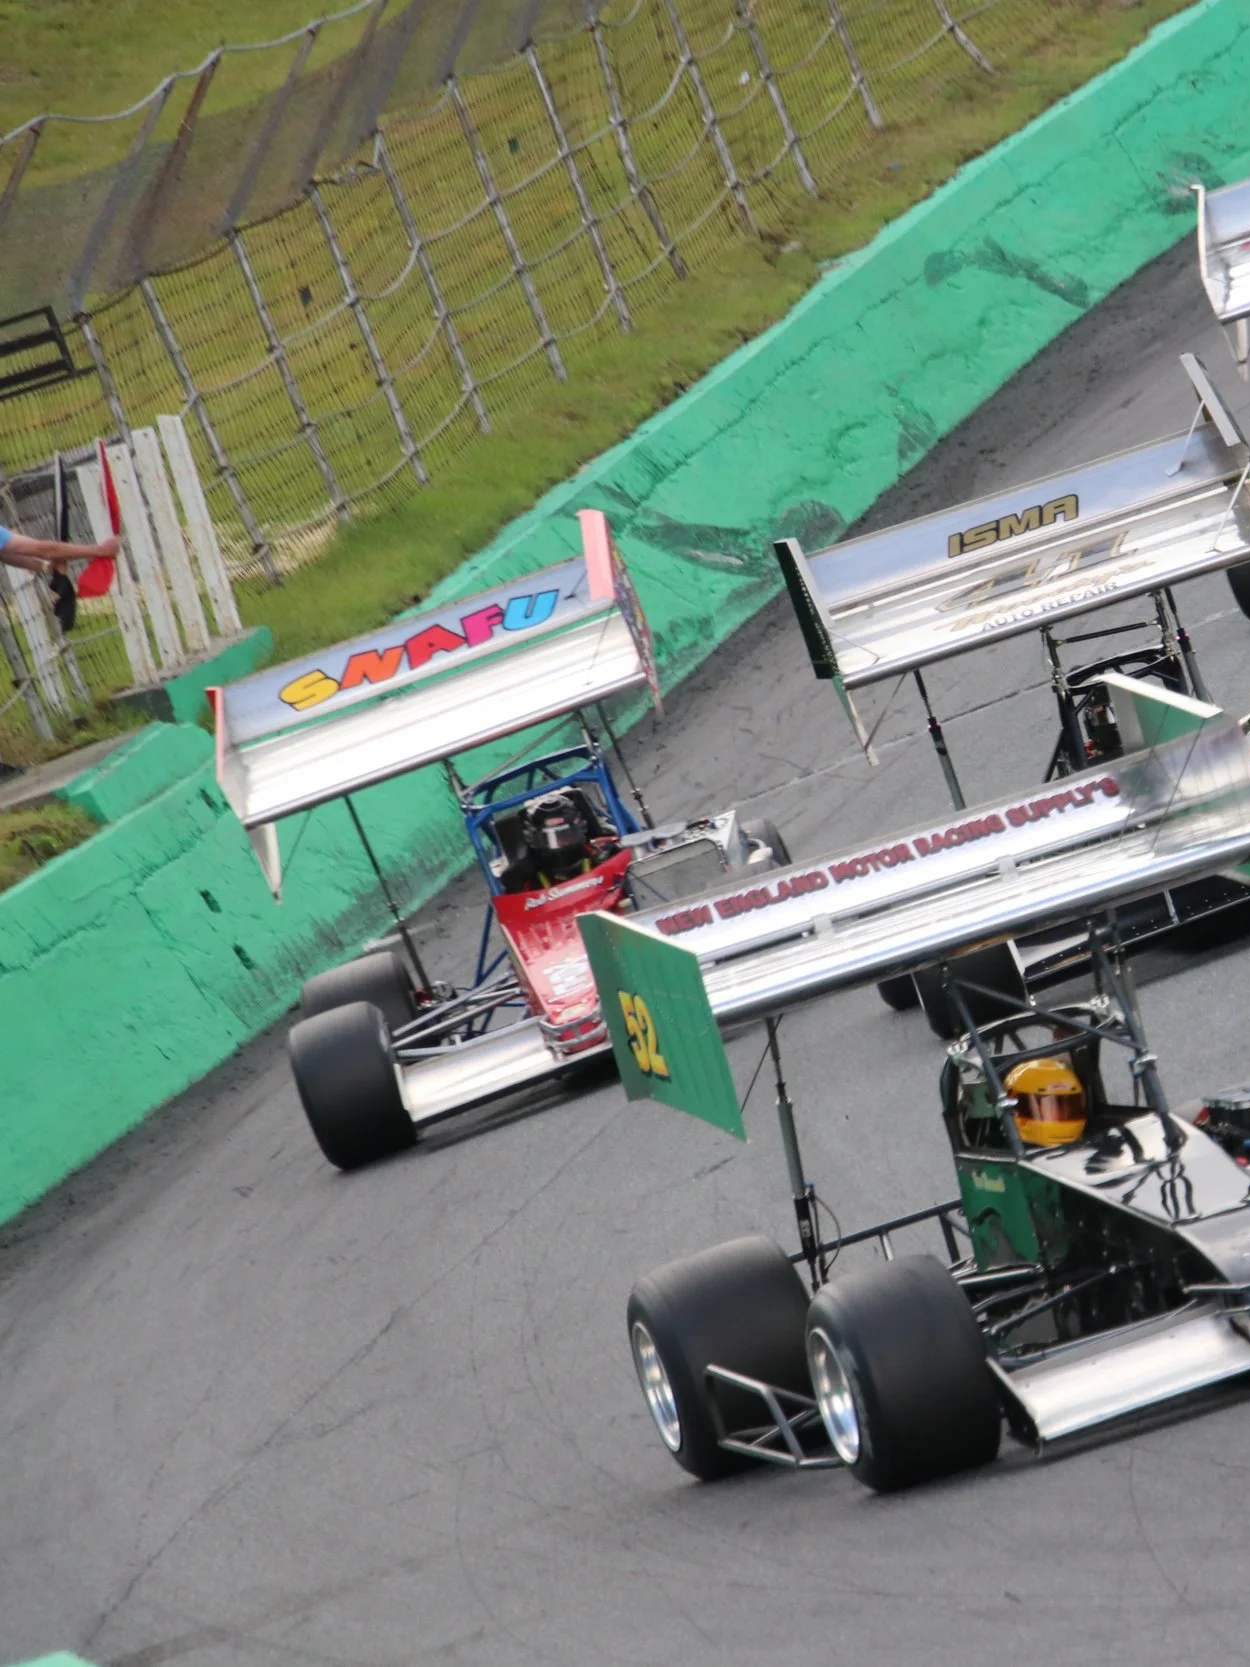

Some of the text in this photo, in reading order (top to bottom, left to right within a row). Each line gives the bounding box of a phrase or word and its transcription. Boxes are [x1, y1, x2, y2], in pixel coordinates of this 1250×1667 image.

[947, 494, 1080, 559] ISMA
[279, 588, 560, 711] SNAFU
[980, 581, 1121, 633] AUTO REPAIR
[655, 776, 1121, 936] NEW ENGLAND MOTOR RACING SUPPLY'S
[617, 988, 671, 1084] 52
